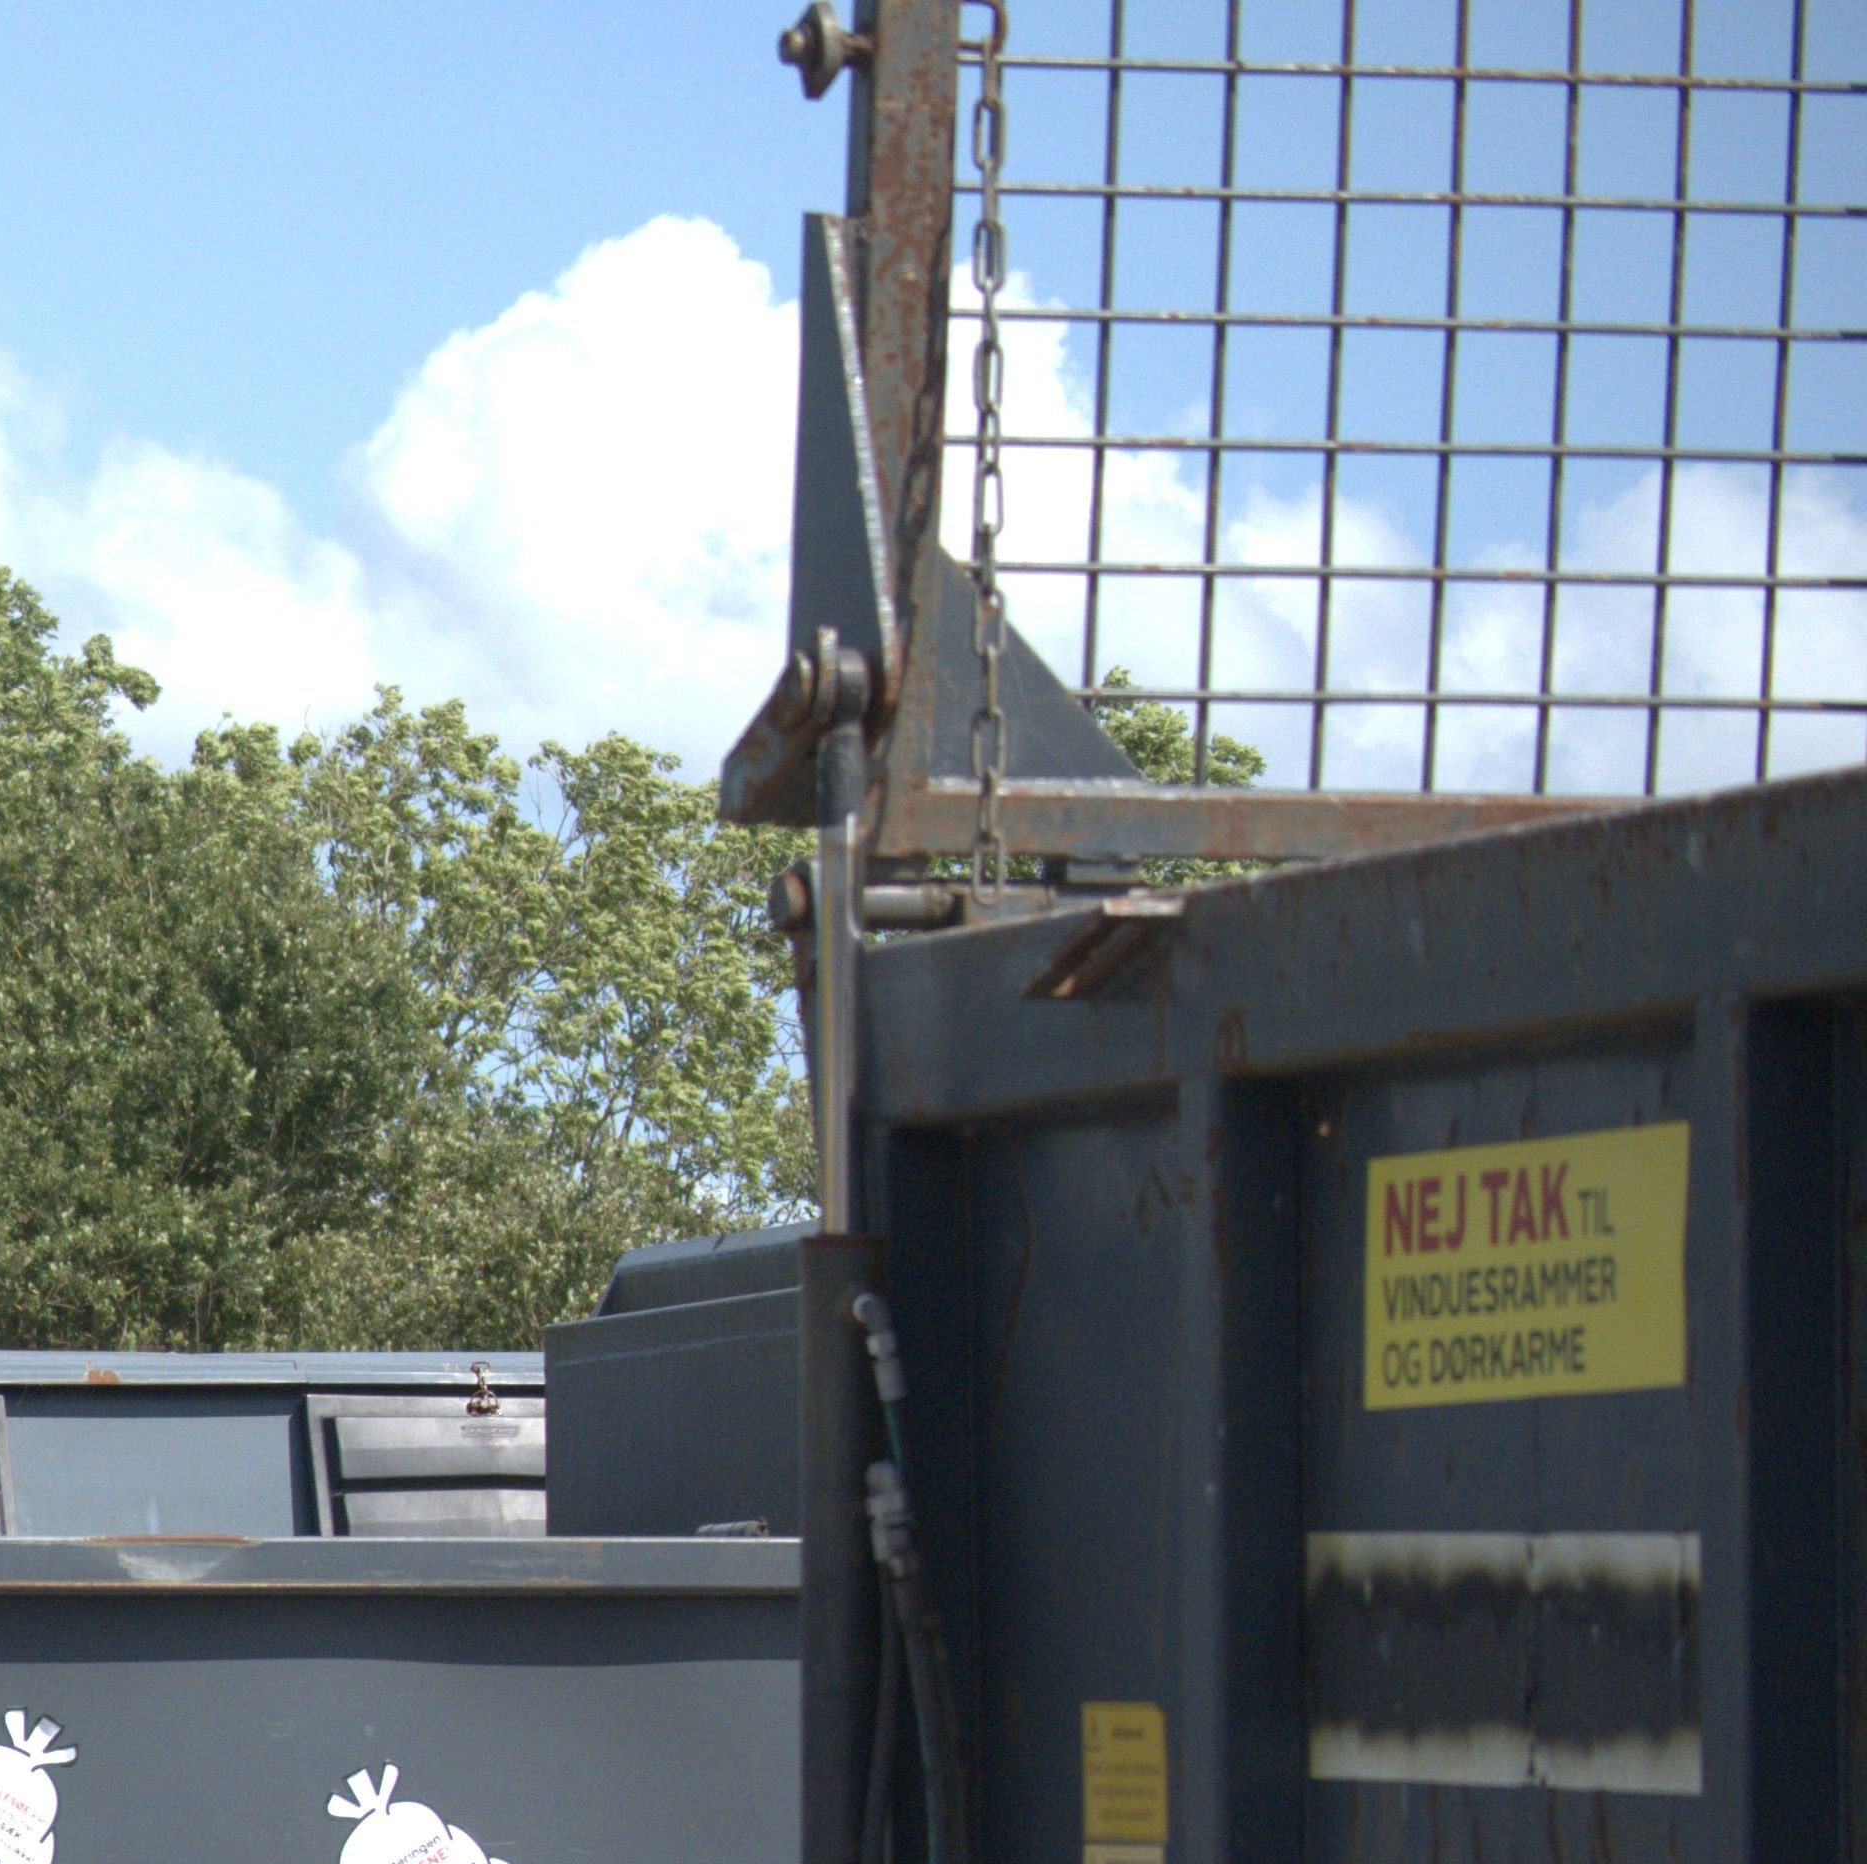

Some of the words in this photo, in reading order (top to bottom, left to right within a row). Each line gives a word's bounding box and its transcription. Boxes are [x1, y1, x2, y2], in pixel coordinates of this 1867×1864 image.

[1385, 1173, 1467, 1256] NEJ
[1480, 1161, 1569, 1246] TAK
[1578, 1185, 1614, 1235] TIL
[1382, 1256, 1616, 1322] VINDUESRAMMER
[1382, 1340, 1422, 1388] OG
[1429, 1325, 1586, 1384] DØRKARME
